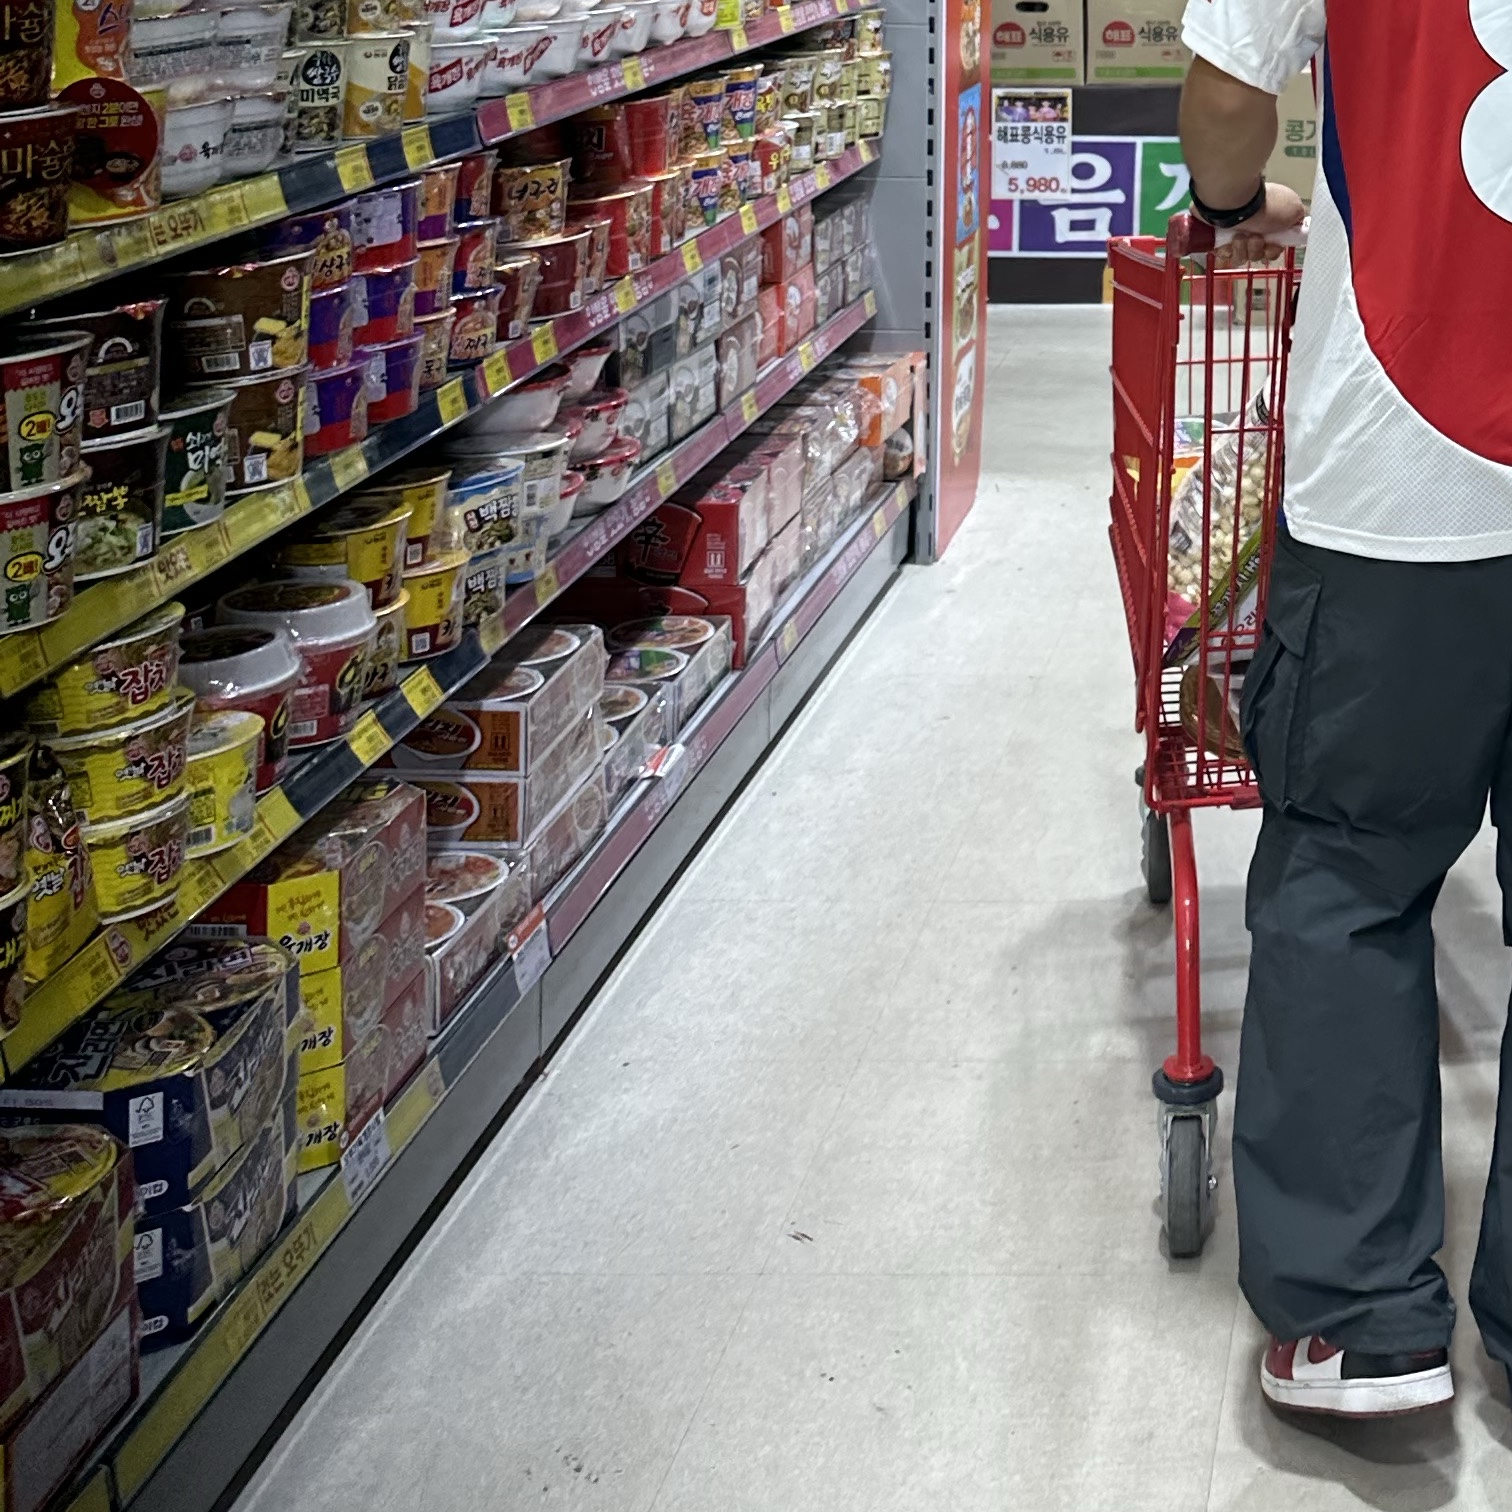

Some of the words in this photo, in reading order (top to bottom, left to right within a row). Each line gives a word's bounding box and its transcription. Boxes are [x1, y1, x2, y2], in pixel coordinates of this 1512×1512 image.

[995, 30, 1022, 42] 해표
[1029, 26, 1069, 42] 식용유
[1105, 28, 1132, 41] 해표
[1138, 25, 1178, 41] 식용유
[301, 86, 340, 102] 미역국
[998, 126, 1066, 144] 해표콩식용유
[508, 178, 559, 203] 너구리
[1008, 178, 1060, 194] 5,980
[1037, 152, 1126, 243] 음
[168, 212, 204, 241] 오뚜기
[280, 931, 329, 958] 육개장
